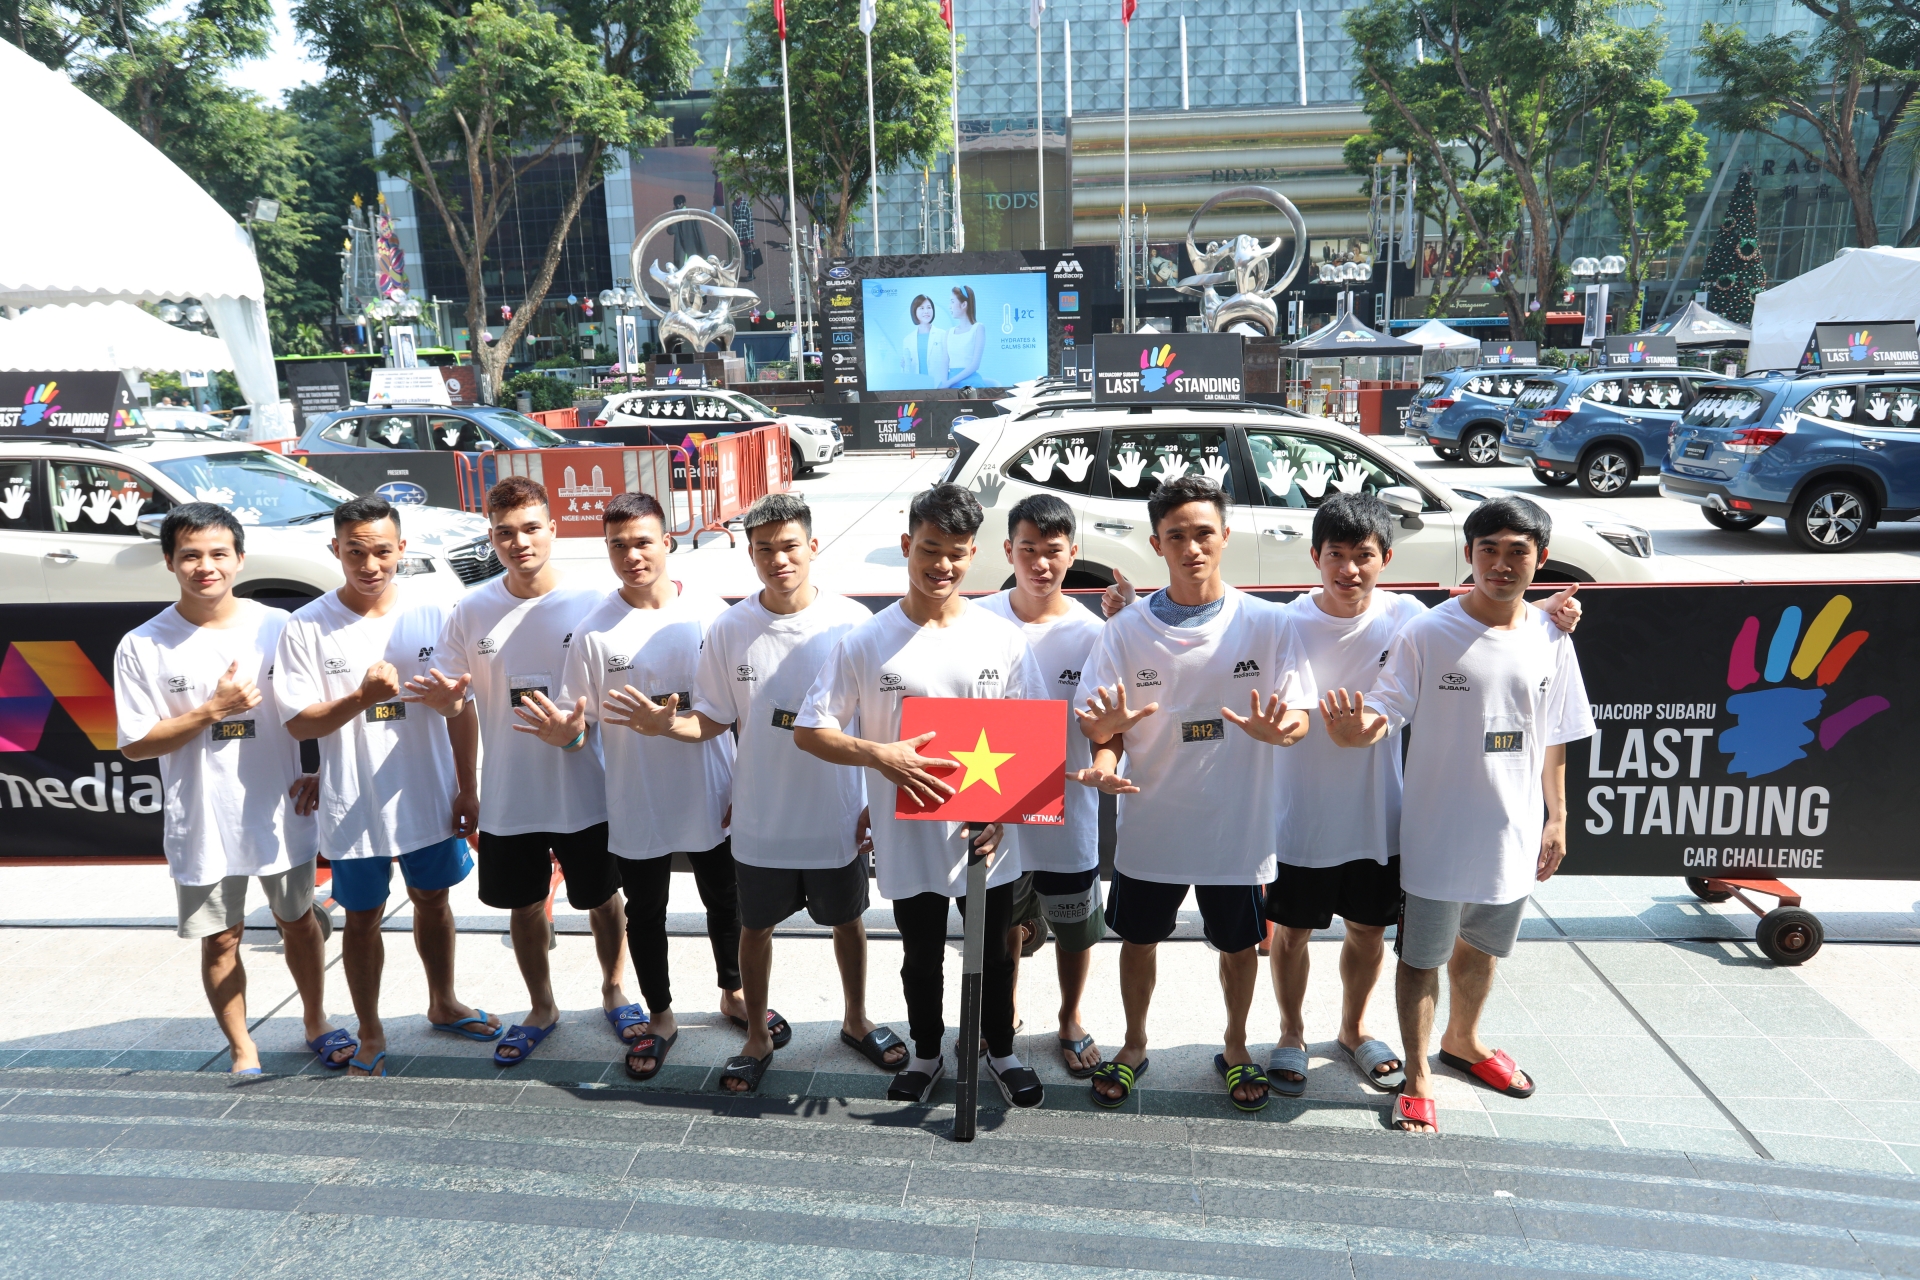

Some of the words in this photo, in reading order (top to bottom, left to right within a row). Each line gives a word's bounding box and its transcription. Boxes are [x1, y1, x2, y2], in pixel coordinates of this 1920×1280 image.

[985, 193, 1038, 210] TOD'S
[1827, 352, 1850, 362] LAST
[1874, 351, 1918, 360] STANDING
[1083, 373, 1092, 382] LA
[1106, 379, 1139, 393] LAST
[1174, 377, 1240, 392] STANDING
[121, 390, 129, 404] 2
[0, 413, 21, 427] AST
[48, 412, 109, 427] STANDING
[1400, 411, 1410, 419] LA
[878, 424, 897, 433] LAST
[879, 433, 916, 443] STANDING
[674, 464, 718, 478] media
[170, 685, 195, 693] SUBARU
[375, 706, 396, 718] R34
[1589, 704, 1652, 720] DIACORP
[1656, 704, 1716, 720] SUBARU
[782, 714, 794, 726] R1
[222, 724, 244, 736] R20
[1192, 724, 1213, 738] R12
[1494, 735, 1514, 748] R17
[1588, 728, 1714, 778] LAST
[0, 762, 163, 814] media
[1584, 785, 1830, 837] STANDING
[1022, 814, 1062, 823] VIETNAM
[1683, 847, 1717, 868] CAR
[1722, 848, 1824, 869] CHALLENGE
[1049, 908, 1086, 918] POWERED
